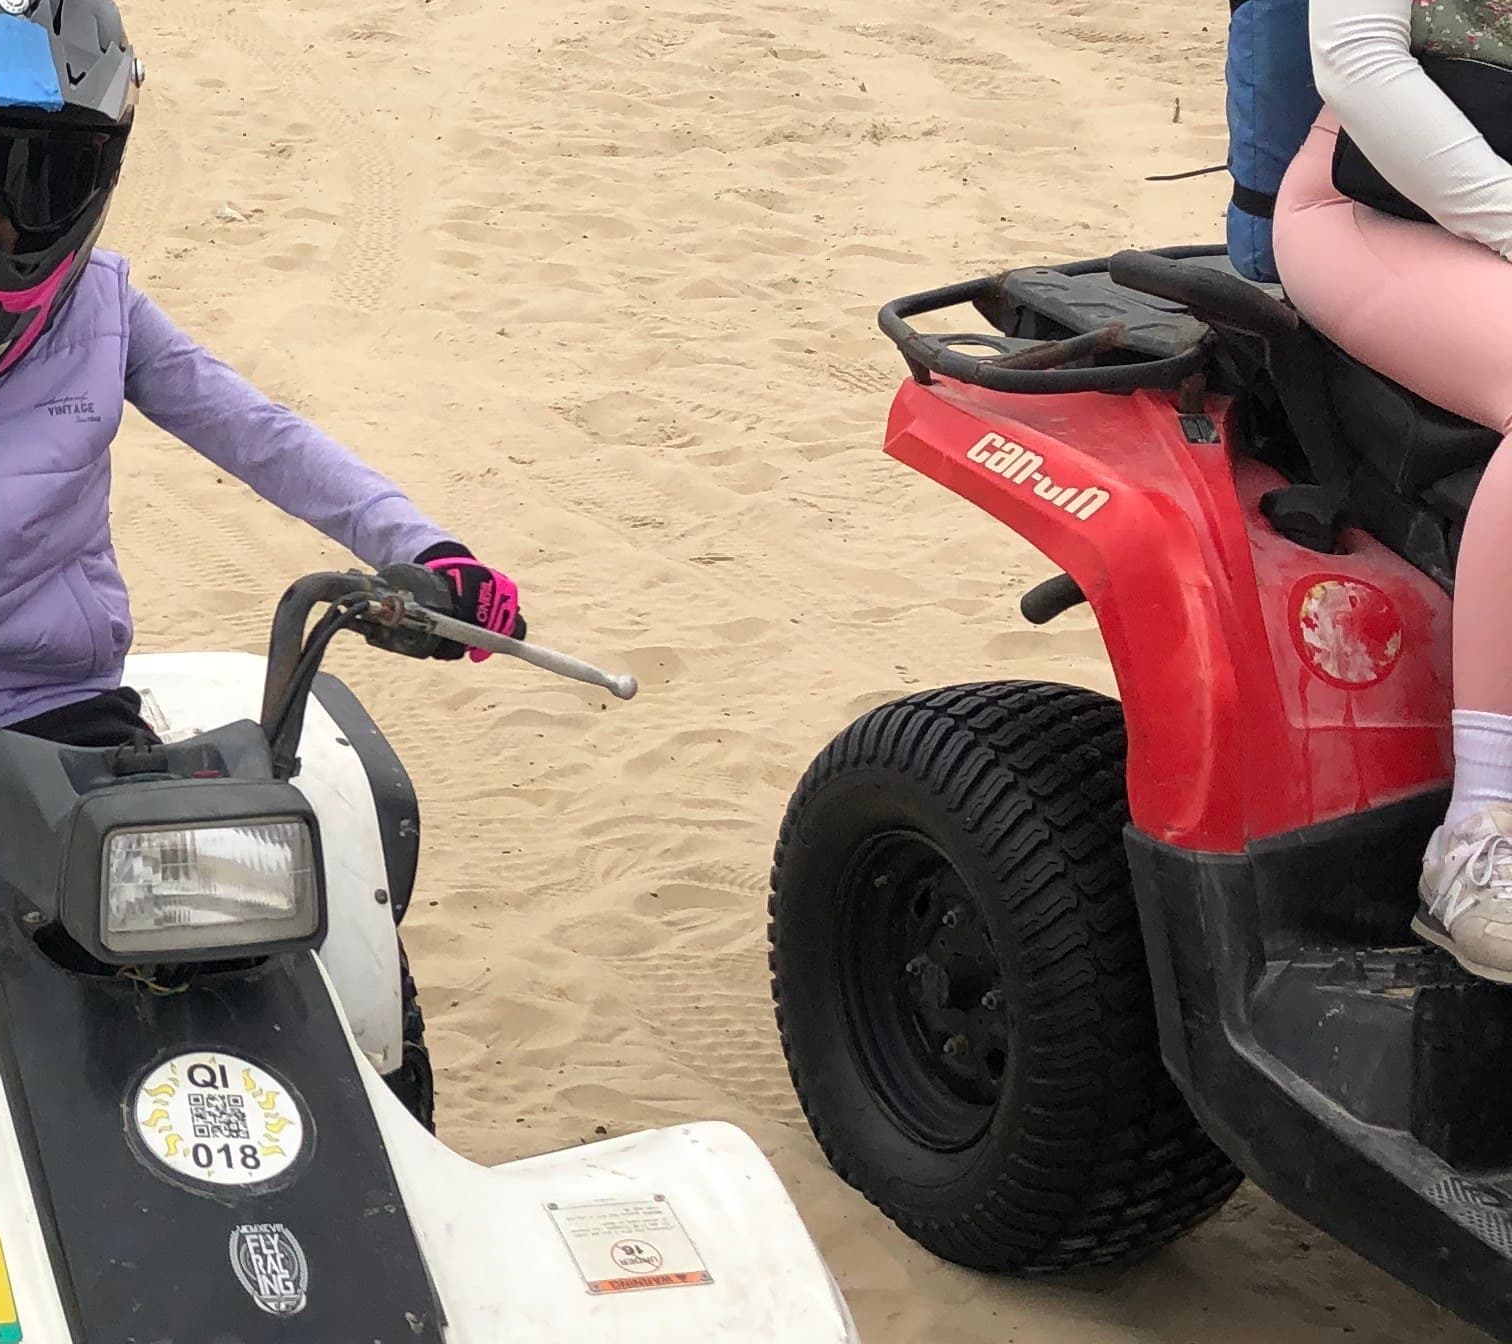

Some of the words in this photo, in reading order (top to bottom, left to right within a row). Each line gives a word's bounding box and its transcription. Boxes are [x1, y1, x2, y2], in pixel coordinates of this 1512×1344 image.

[47, 402, 96, 417] VINTAGE
[186, 1063, 230, 1090] QI
[191, 1142, 262, 1170] 018
[245, 1233, 280, 1255] FLY
[621, 1244, 645, 1256] 16
[619, 1255, 659, 1267] UNDER
[607, 1274, 674, 1291] WARNING
